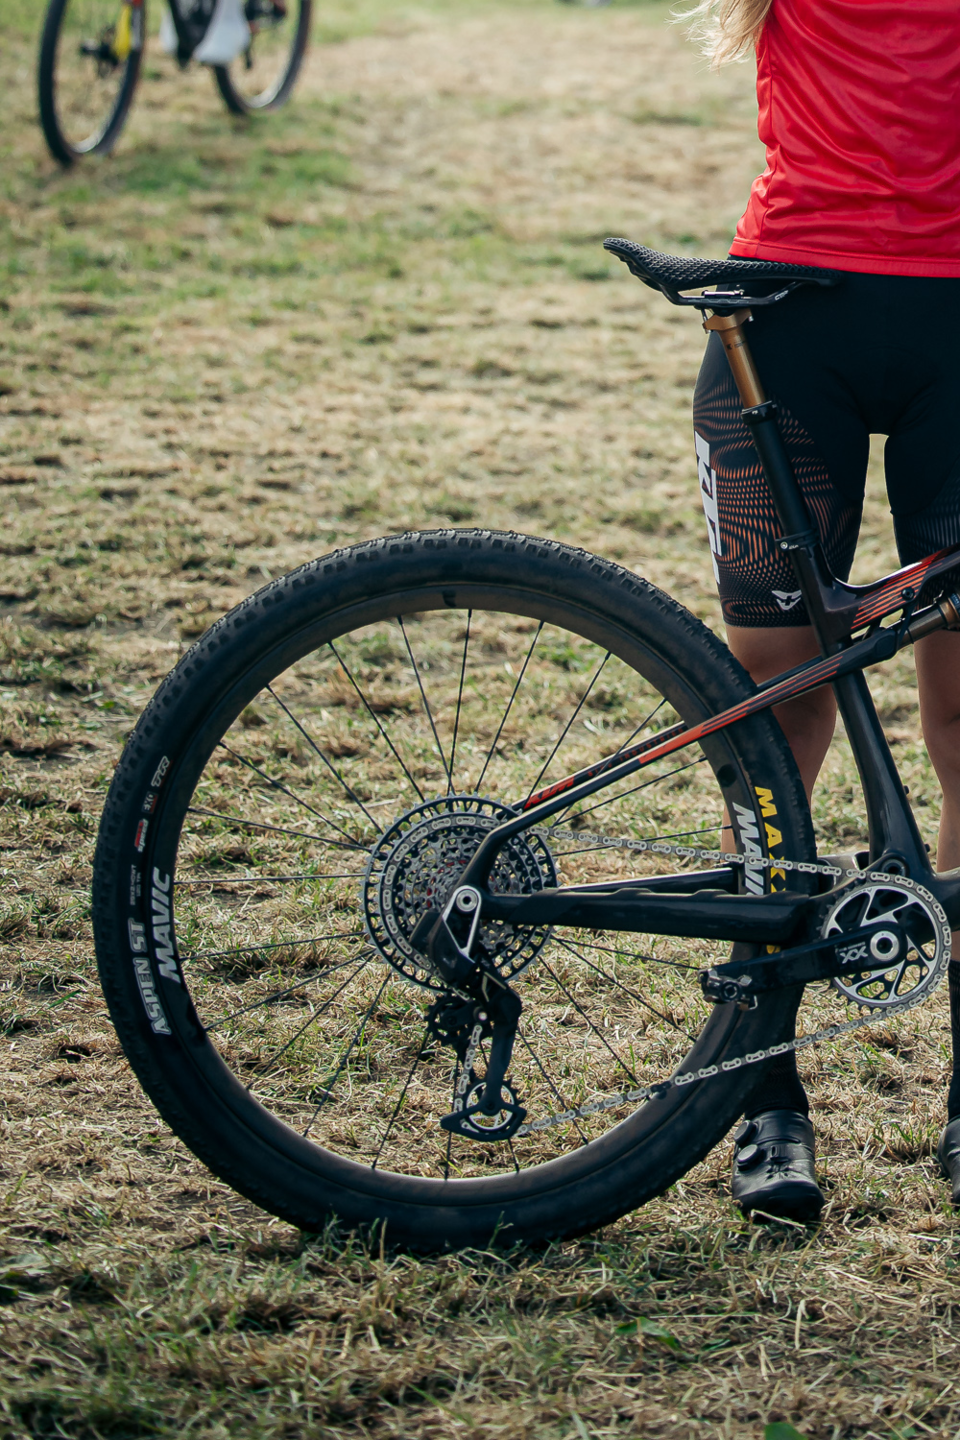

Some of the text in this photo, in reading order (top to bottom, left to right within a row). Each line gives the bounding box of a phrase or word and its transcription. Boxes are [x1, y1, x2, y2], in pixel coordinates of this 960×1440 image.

[524, 776, 575, 810] KTM
[732, 802, 765, 895] MAVI
[754, 786, 787, 894] MAX
[152, 867, 181, 984] MAVIC
[133, 957, 172, 1035] ASPEN
